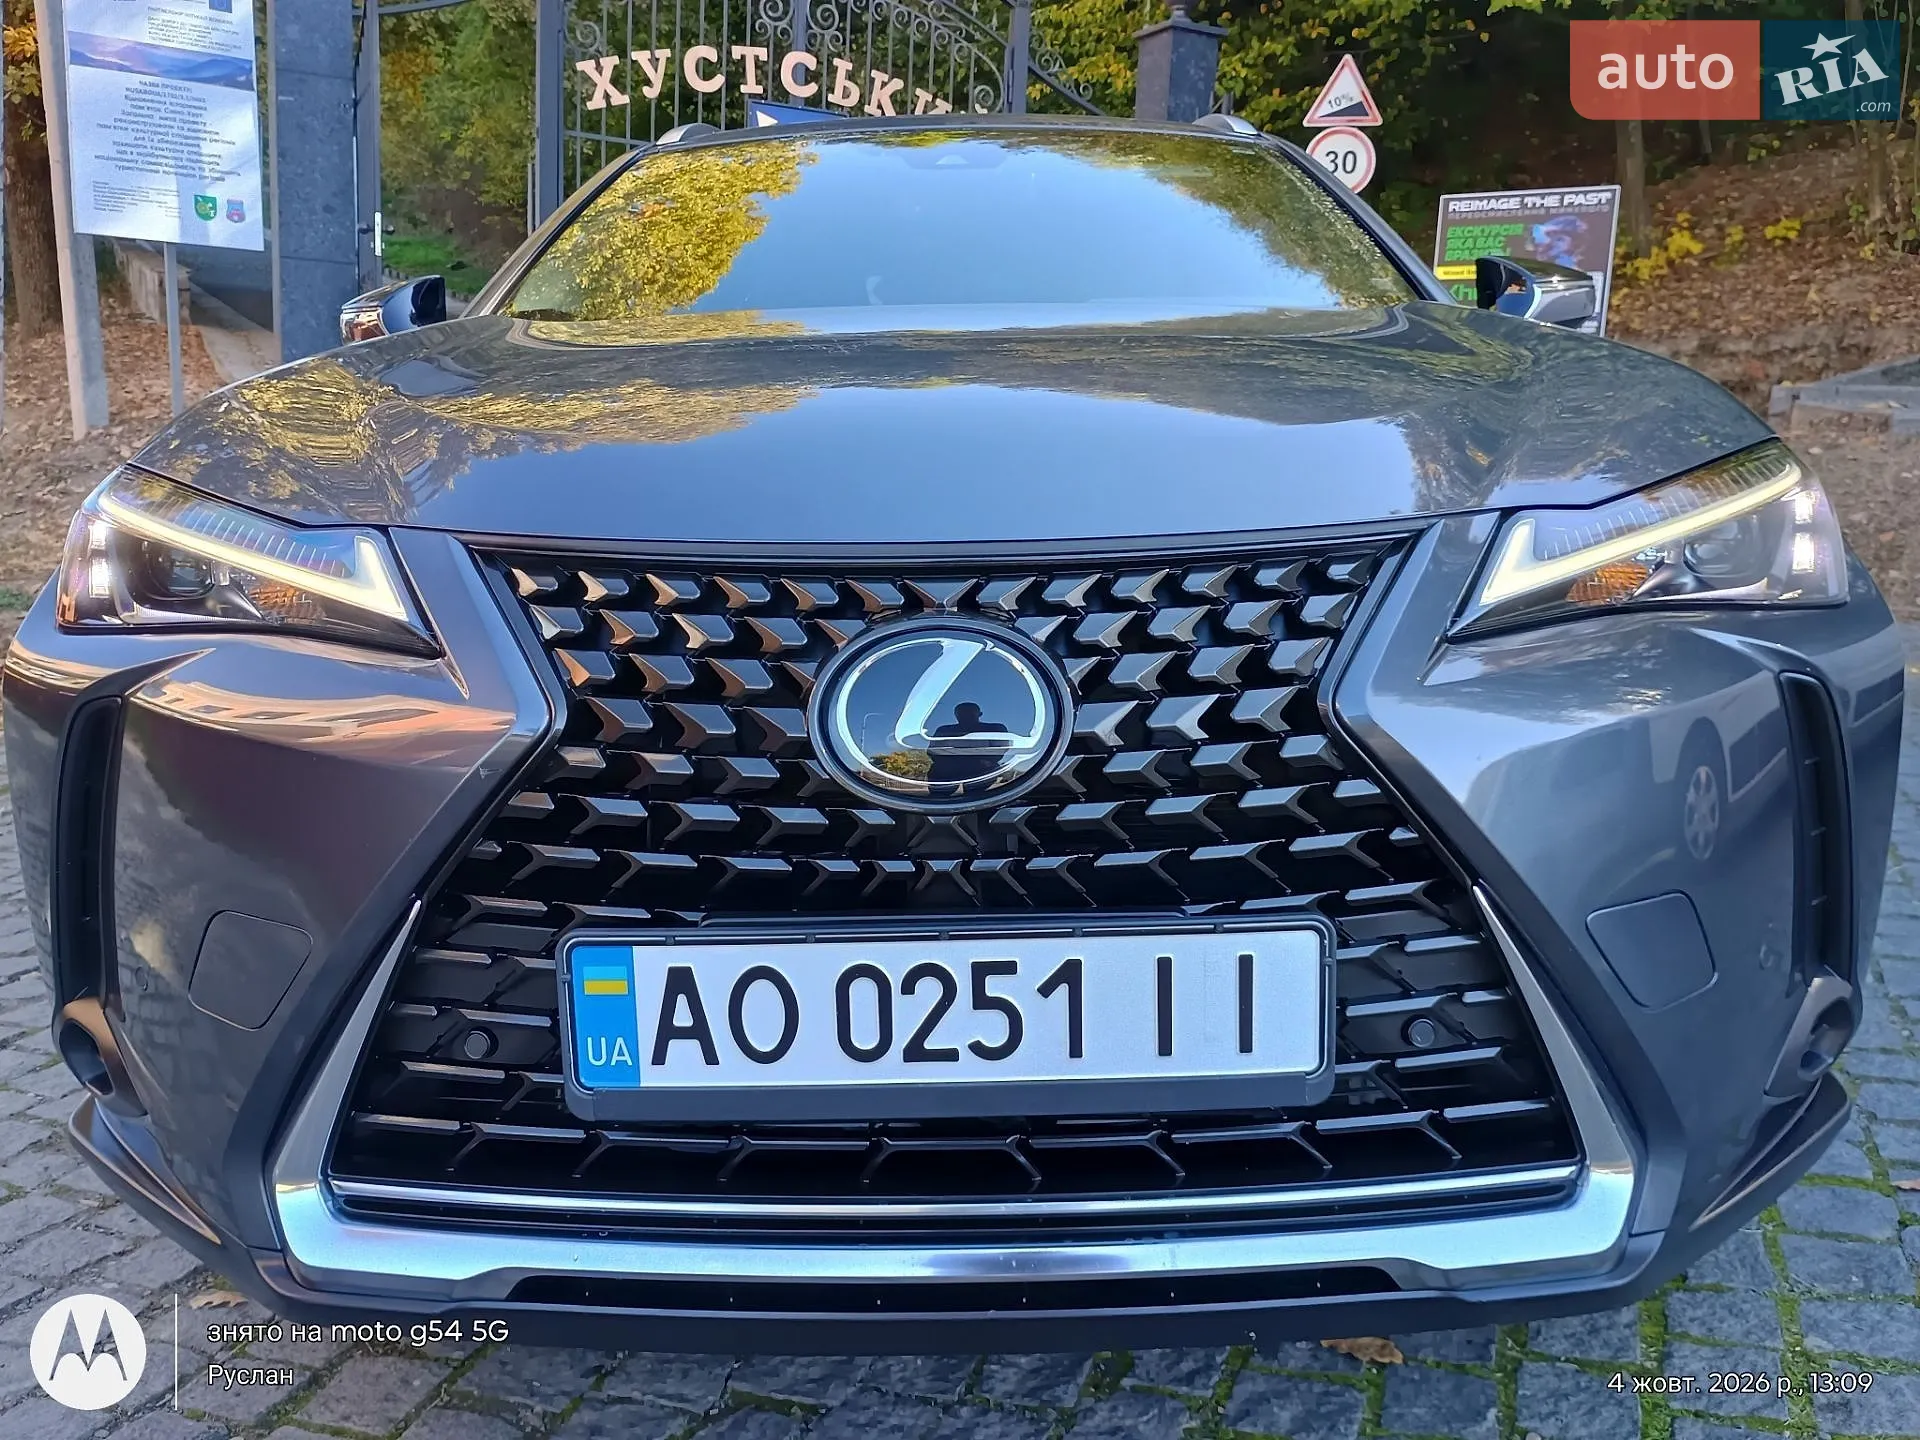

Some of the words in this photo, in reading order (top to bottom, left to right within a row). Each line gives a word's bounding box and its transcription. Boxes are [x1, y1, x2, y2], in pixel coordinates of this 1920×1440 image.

[1328, 92, 1354, 108] 10%
[1325, 150, 1357, 174] 30
[1448, 196, 1522, 213] REIMAGE
[1524, 193, 1561, 208] THE
[1563, 191, 1613, 207] PAST
[651, 964, 800, 1066] AO
[835, 957, 1084, 1063] 0251
[588, 1036, 633, 1067] UA
